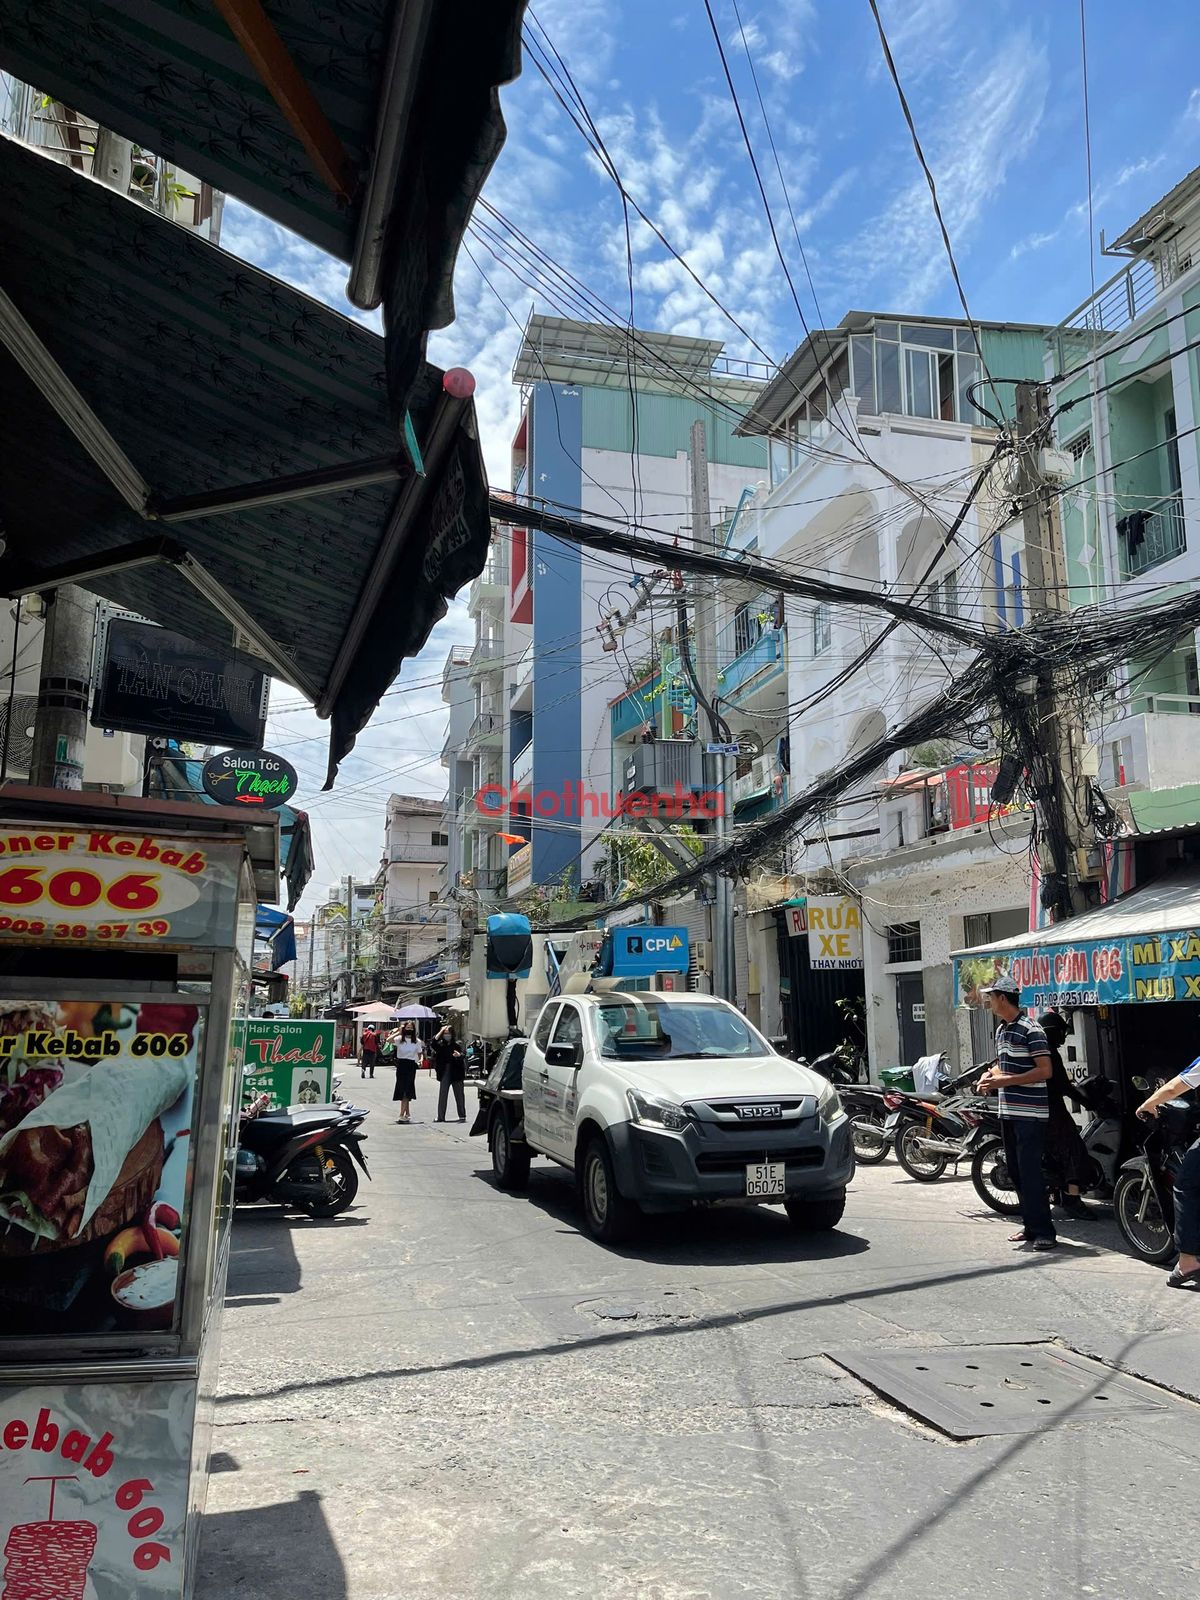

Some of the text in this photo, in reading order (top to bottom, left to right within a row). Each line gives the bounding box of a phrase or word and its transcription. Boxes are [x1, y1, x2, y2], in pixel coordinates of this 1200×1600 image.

[222, 756, 280, 771] Salon Tóc
[87, 832, 208, 876] Kebab
[0, 867, 162, 911] 606
[53, 923, 88, 940] 38
[95, 924, 129, 940] 37
[136, 918, 170, 937] 39
[645, 938, 675, 952] CPL
[819, 934, 852, 957] XE
[1133, 937, 1162, 966] MÌ
[812, 959, 836, 969] THAY
[1011, 947, 1051, 995] QUÁN
[1053, 946, 1089, 985] CƠM
[249, 1024, 270, 1034] Hair
[273, 1024, 302, 1034] Salon
[25, 1030, 122, 1058] Kebab
[130, 1033, 189, 1059] 606
[739, 1106, 780, 1118] ISUZU
[756, 1165, 777, 1180] 51E
[748, 1180, 784, 1194] 050.75
[0, 1407, 115, 1478] ebab
[115, 1478, 171, 1571] 606
